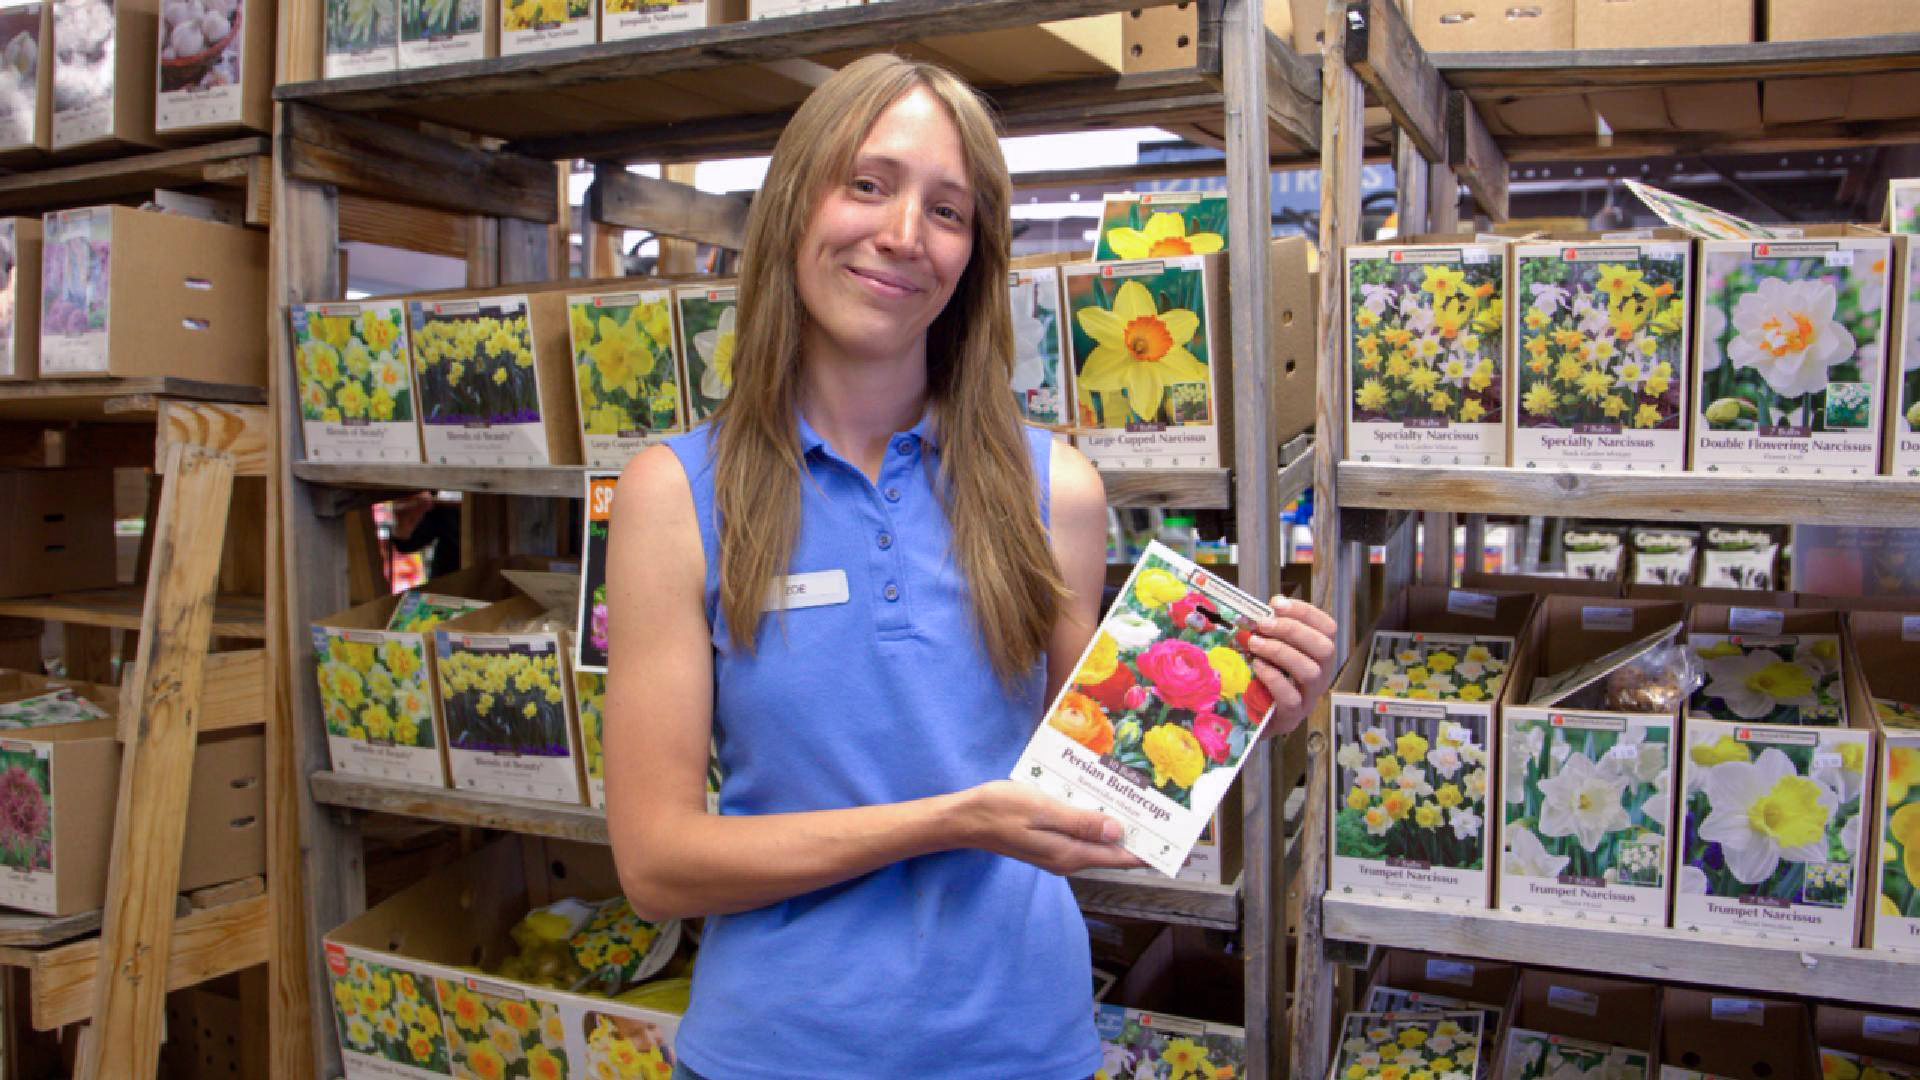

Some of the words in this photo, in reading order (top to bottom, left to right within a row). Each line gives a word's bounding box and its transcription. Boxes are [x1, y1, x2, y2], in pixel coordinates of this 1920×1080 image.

[1159, 431, 1207, 443] Narcissus
[1373, 430, 1422, 443] Specialty
[1426, 429, 1480, 441] Narcissus
[1541, 436, 1593, 449] Specialty
[1597, 436, 1655, 448] Narcissus
[1700, 438, 1744, 450] Double
[1749, 438, 1809, 453] Flowering
[1812, 440, 1872, 453] Narcissus
[1062, 749, 1105, 781] Persian
[1106, 775, 1170, 821] Buttercups
[1359, 865, 1404, 879] Trumpet
[1406, 870, 1459, 884] Narcissus
[1529, 883, 1576, 896] Trumpet
[1580, 888, 1636, 902] Narcissus
[1708, 903, 1758, 917] Trumpet
[1762, 908, 1822, 924] Narcissus
